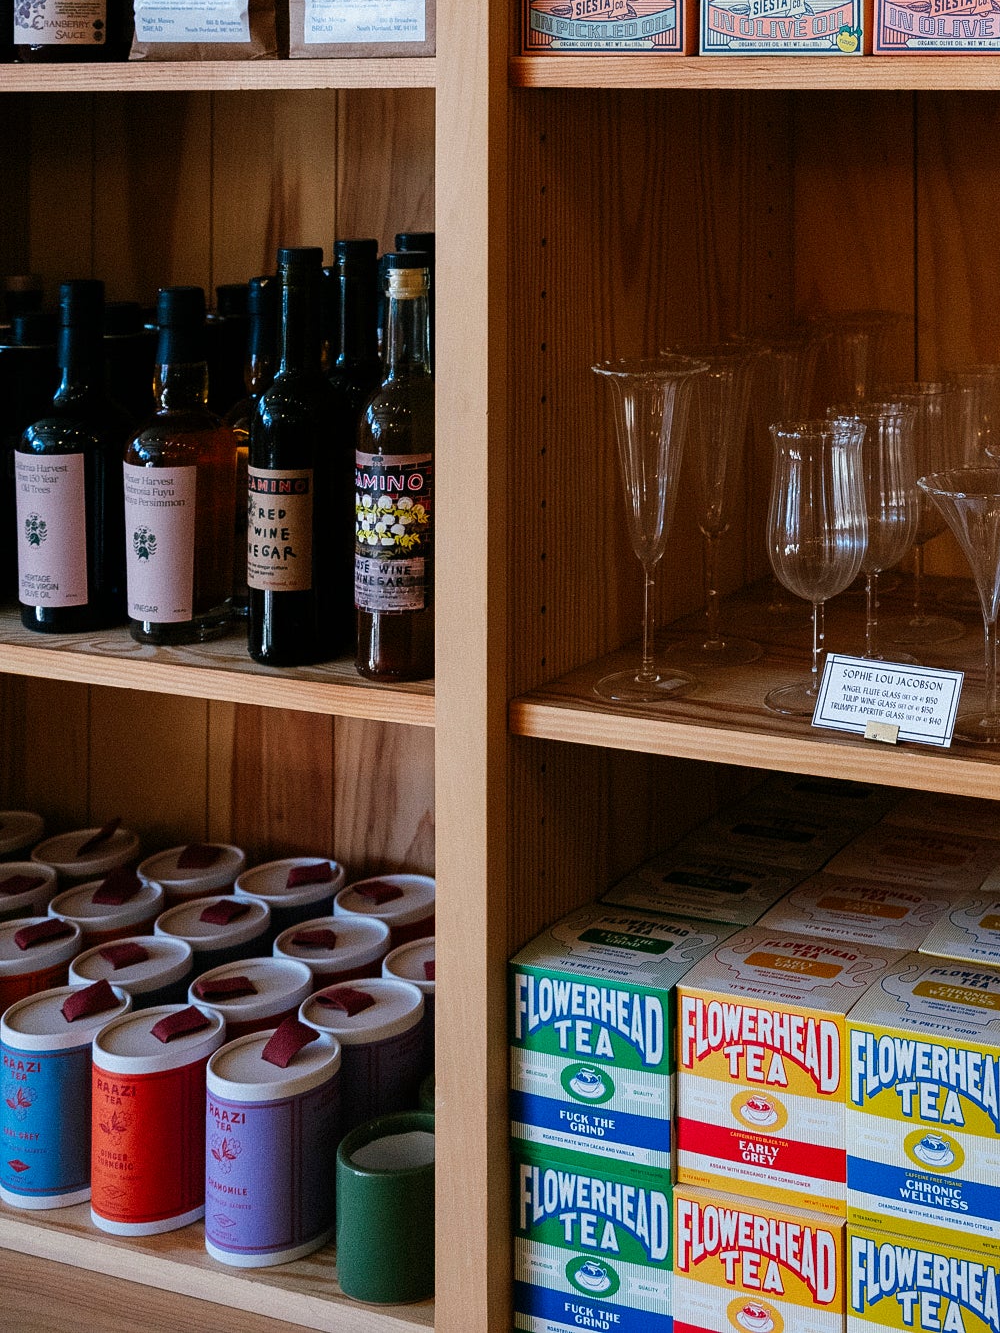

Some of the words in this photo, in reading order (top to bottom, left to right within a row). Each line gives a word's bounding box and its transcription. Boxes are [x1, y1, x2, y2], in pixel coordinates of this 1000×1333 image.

[32, 15, 90, 30] CRANBERRY
[534, 13, 552, 33] IN
[556, 20, 637, 39] PICKLED
[642, 15, 671, 35] OIL
[890, 8, 913, 31] IN
[920, 16, 993, 37] OLIVE
[55, 29, 86, 40] SAUCE
[36, 464, 68, 473] Harvest
[41, 475, 59, 483] Year
[142, 477, 174, 486] Harvest
[31, 486, 51, 494] Trees
[152, 488, 175, 497] Fuyu
[138, 497, 185, 507] Persimmon
[258, 508, 286, 520] RED
[254, 527, 290, 541] WINE
[379, 566, 411, 576] WINE
[843, 669, 873, 681] SOPHIE
[875, 674, 893, 684] LOU
[896, 677, 943, 691] JACOBSON
[842, 684, 862, 694] ANGEL
[863, 687, 880, 696] FLUTE
[882, 690, 901, 699] GLASS
[925, 696, 938, 705] $150
[843, 694, 859, 702] TULIP
[861, 696, 876, 706] WINE
[878, 699, 896, 708] GLASS
[921, 706, 934, 714] $150
[830, 702, 858, 713] TRUMPET
[859, 706, 884, 716] APERITIF
[886, 710, 904, 720] GLASS
[929, 717, 942, 725] $140
[515, 973, 664, 1065] FLOWERHEAD
[554, 1019, 615, 1059] TEA
[681, 995, 840, 1093] FLOWERHEAD
[3, 1055, 41, 1073] RAAZI
[723, 1044, 788, 1086] TEA
[11, 1070, 27, 1081] TEA
[97, 1079, 136, 1097] RAAZI
[105, 1095, 122, 1105] TEA
[895, 1082, 965, 1125] TEA
[209, 1103, 246, 1125] RAAZI
[559, 1110, 589, 1126] FUCK
[593, 1116, 616, 1130] THE
[216, 1120, 232, 1132] TEA
[570, 1122, 605, 1136] GRIND
[739, 1140, 780, 1156] EARLY
[742, 1153, 775, 1166] GREY
[208, 1176, 248, 1196] CHAMOMILE
[905, 1179, 962, 1200] CHRONIC
[899, 1187, 969, 1211] WELLNESS
